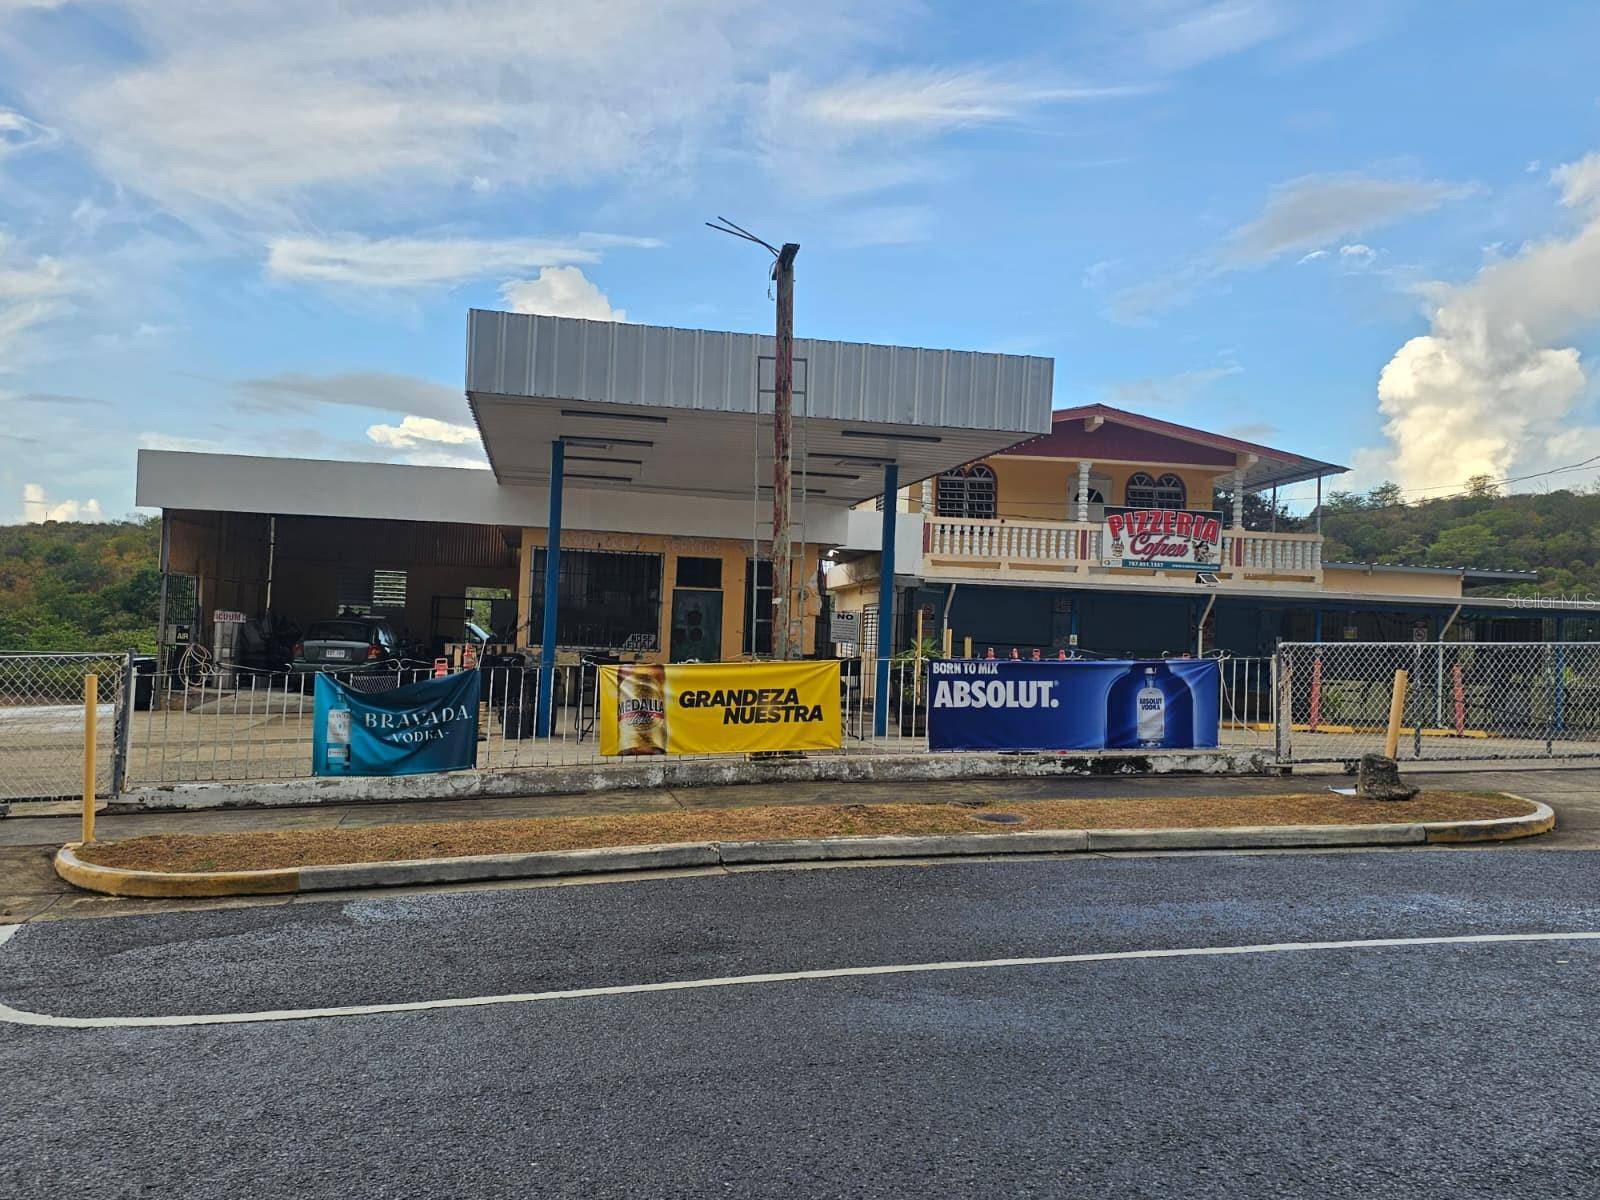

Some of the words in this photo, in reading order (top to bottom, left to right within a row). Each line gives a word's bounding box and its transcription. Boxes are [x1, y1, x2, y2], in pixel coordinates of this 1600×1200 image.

[1107, 511, 1220, 545] PIZZERIA
[176, 632, 190, 640] AIR
[932, 662, 961, 674] BORN
[963, 662, 976, 674] TO
[978, 662, 999, 674] MIX
[618, 699, 665, 713] MEDALLA
[679, 688, 800, 708] GRANDEZA
[723, 705, 824, 724] NUESTRA
